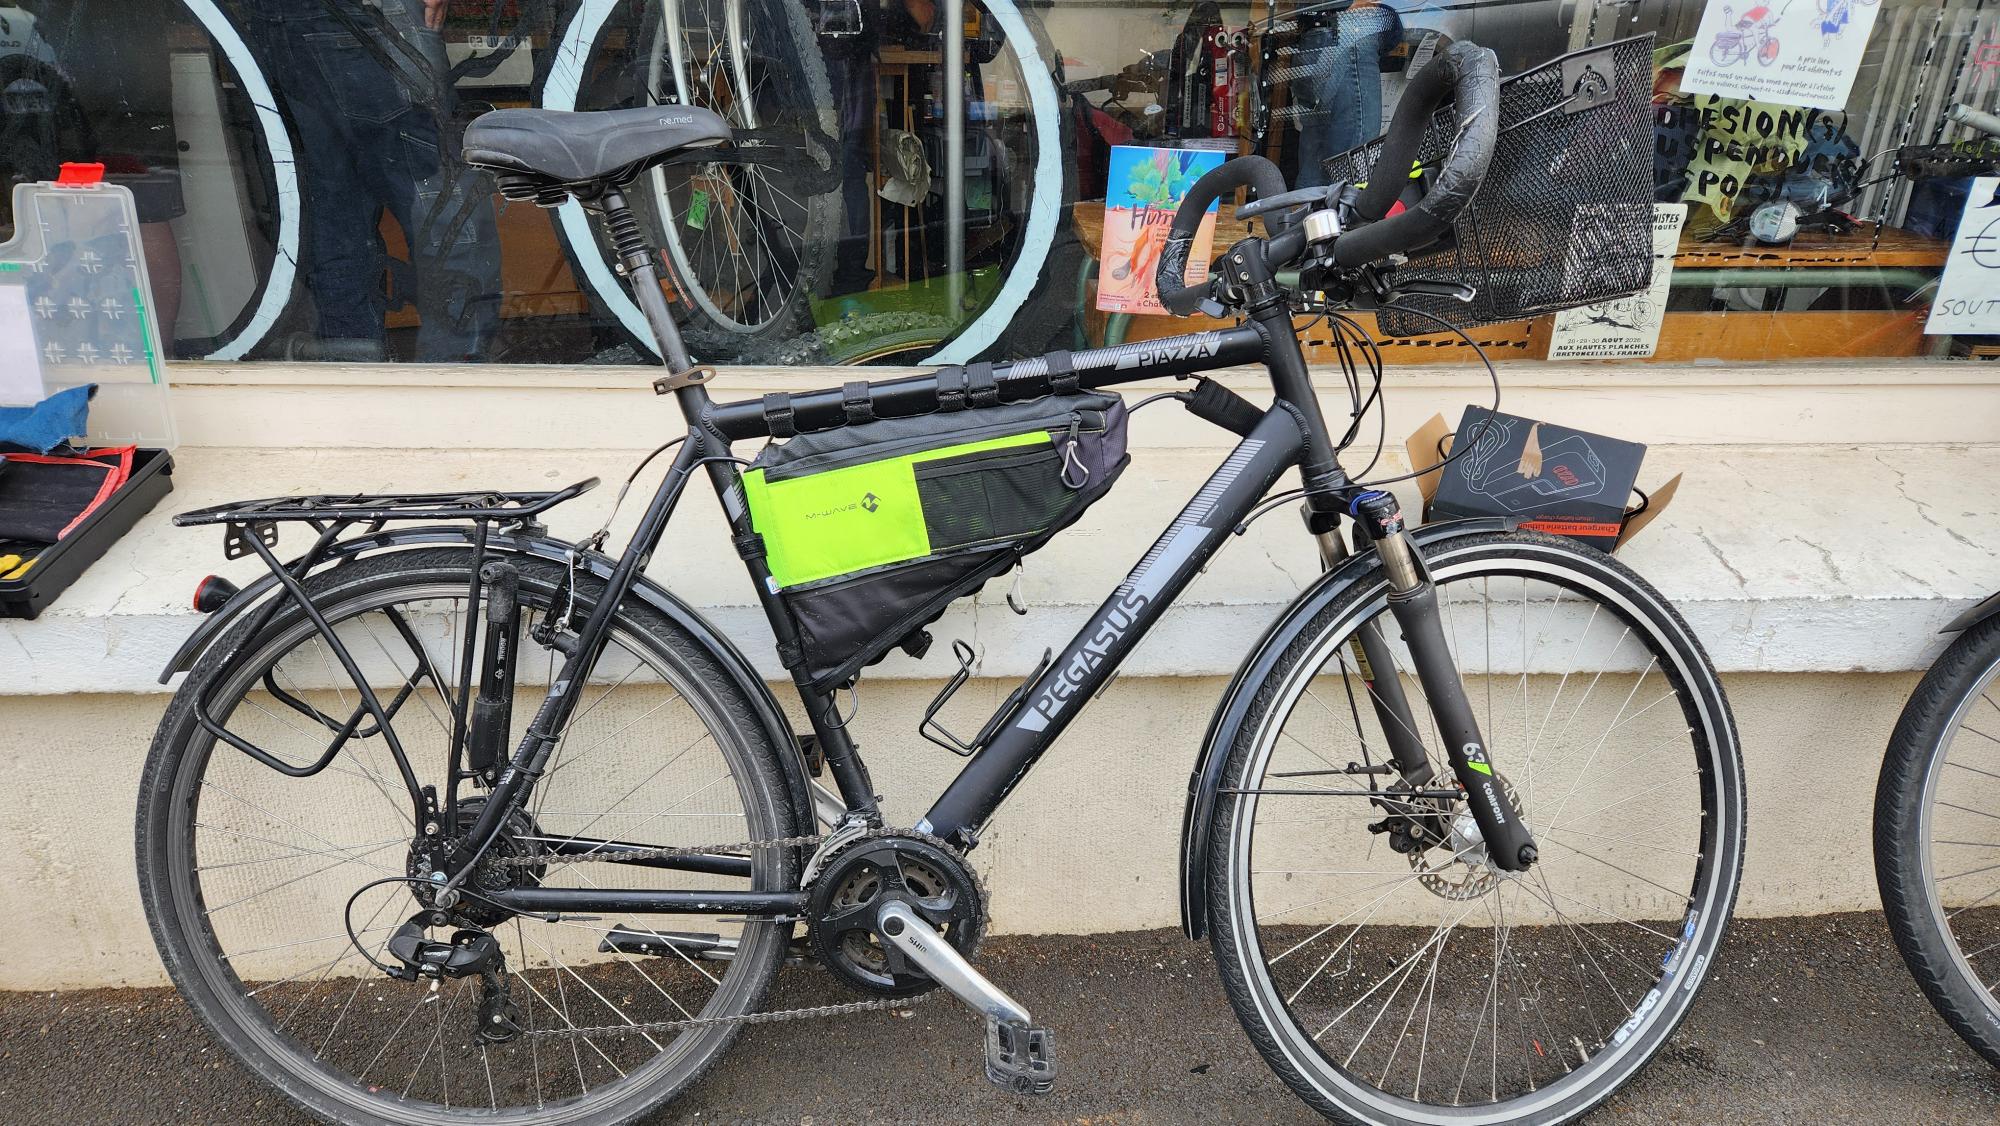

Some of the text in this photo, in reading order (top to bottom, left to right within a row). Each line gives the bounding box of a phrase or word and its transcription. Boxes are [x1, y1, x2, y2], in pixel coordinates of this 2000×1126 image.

[1937, 299, 2000, 316] SOUT
[1139, 343, 1210, 368] PIAZZA
[1547, 524, 1577, 532] batterie
[1579, 525, 1616, 533] Chargeur
[1034, 588, 1150, 720] PEGASUS
[1483, 781, 1505, 824] COMFORT
